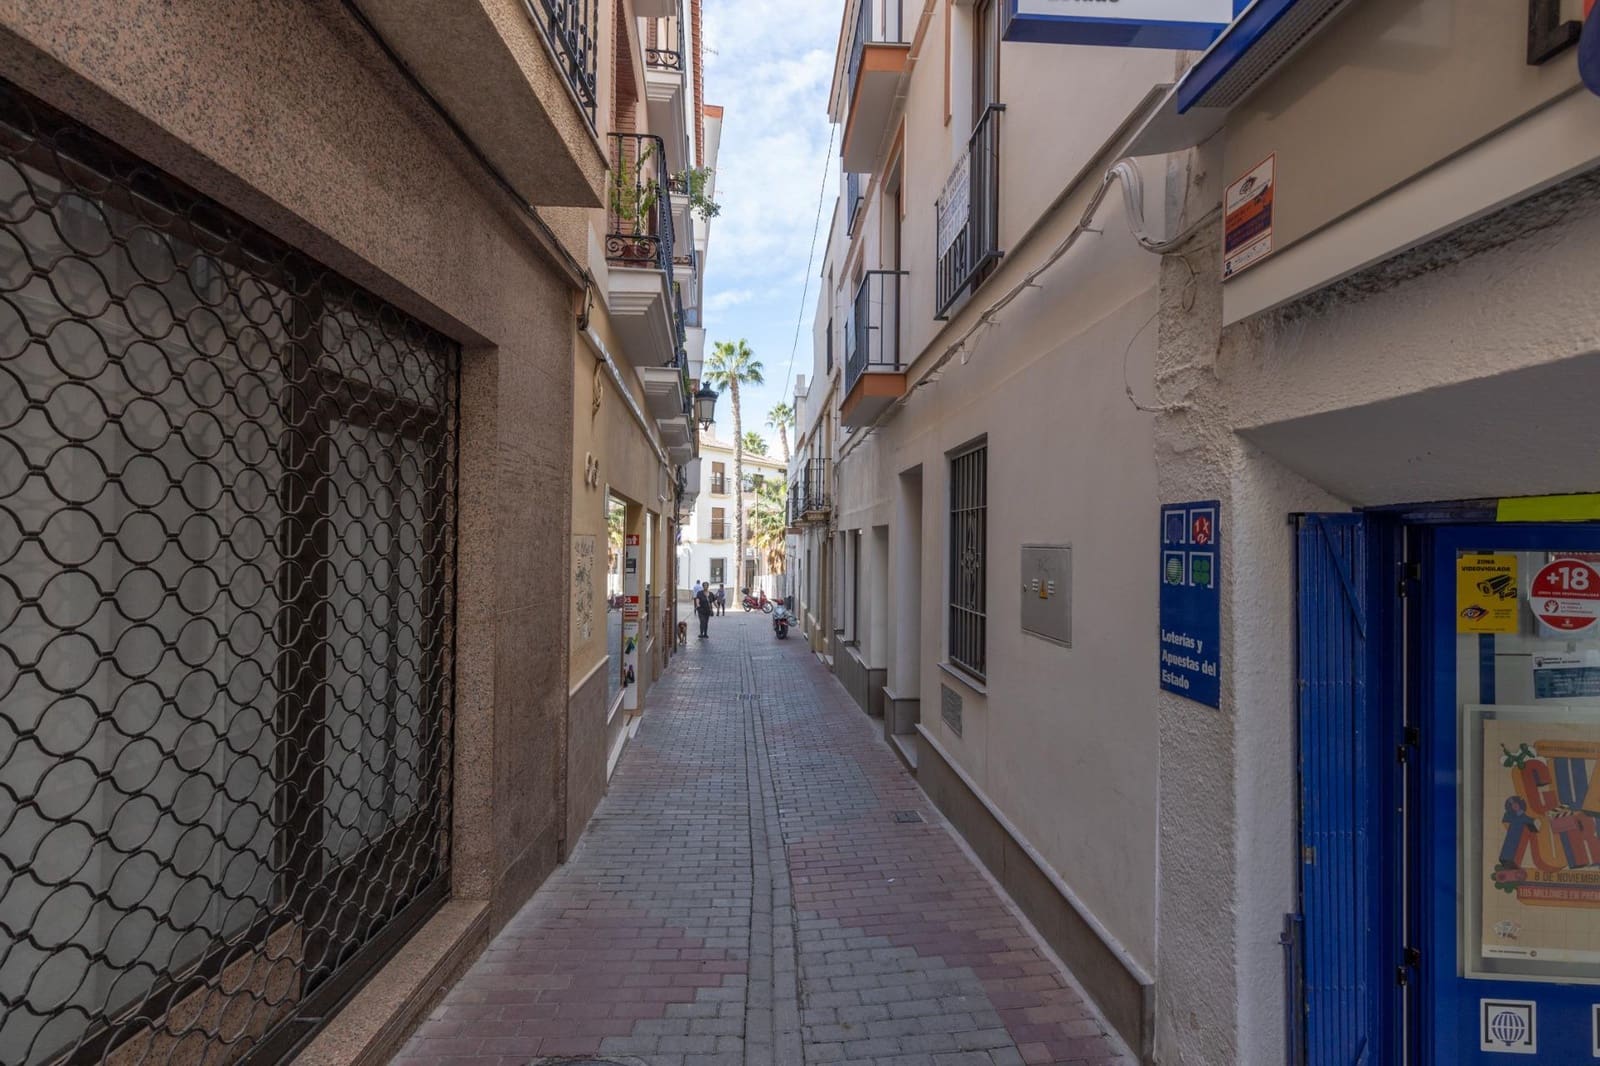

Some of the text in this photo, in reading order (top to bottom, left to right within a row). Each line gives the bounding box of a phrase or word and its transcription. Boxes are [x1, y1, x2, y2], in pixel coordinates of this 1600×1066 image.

[1546, 567, 1589, 591] +18
[1162, 629, 1203, 654] Loterías y
[1162, 649, 1216, 677] Apuestas del
[1162, 669, 1189, 690] Estado
[1535, 871, 1540, 881] 8
[1543, 871, 1552, 882] DE
